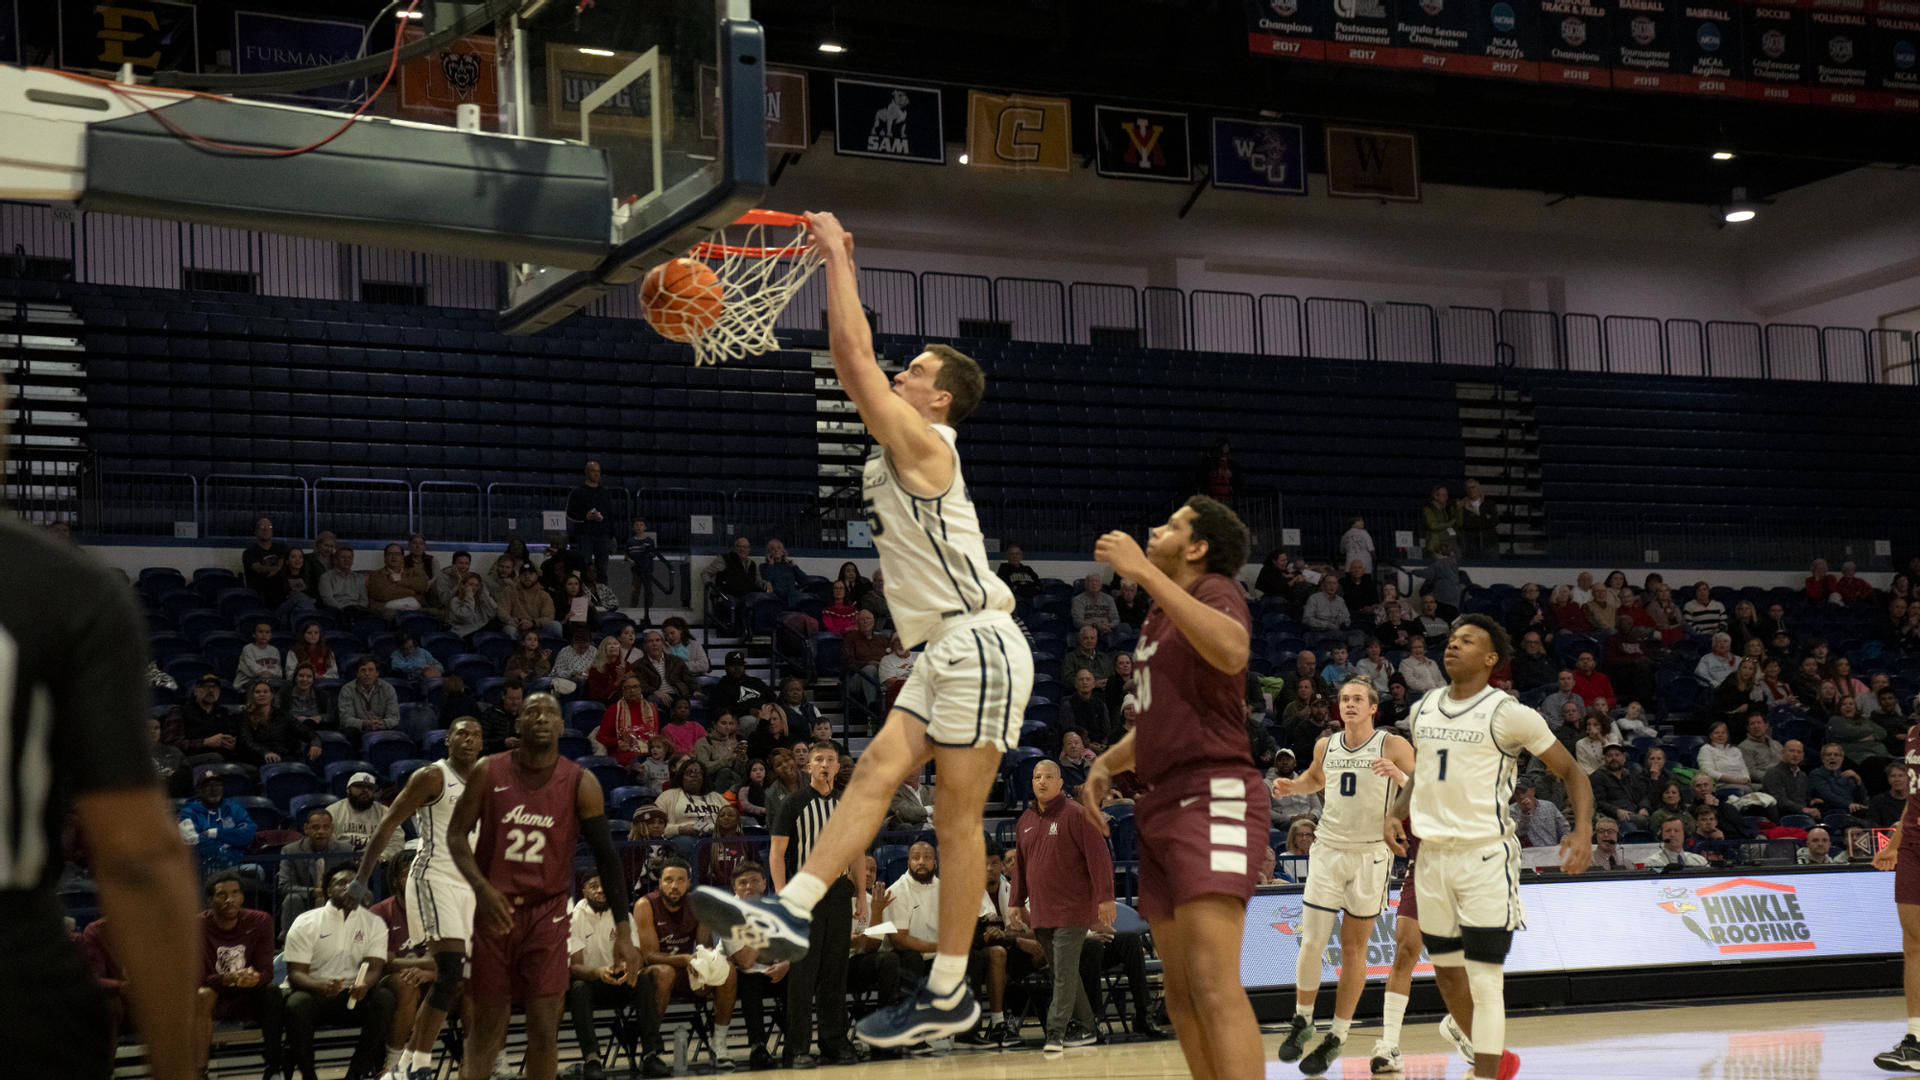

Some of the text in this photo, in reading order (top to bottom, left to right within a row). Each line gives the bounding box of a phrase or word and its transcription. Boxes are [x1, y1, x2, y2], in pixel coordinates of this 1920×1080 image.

[1755, 7, 1791, 20] SOCCER
[1258, 18, 1313, 34] Champions
[1335, 22, 1388, 36] Postseason
[1398, 22, 1468, 39] Regular Season
[1334, 32, 1390, 45] Tournament
[1408, 34, 1459, 48] Champions
[1492, 37, 1518, 48] NCAA
[1272, 40, 1301, 53] 2017
[1486, 45, 1524, 60] Playoffs
[1620, 46, 1670, 59] Tournament
[246, 46, 335, 67] FURMAN
[1349, 48, 1377, 60] 2017
[1422, 54, 1446, 67] 2017
[1551, 48, 1600, 62] Champions
[1492, 62, 1518, 73] 2017
[1622, 55, 1670, 69] Champions
[1698, 57, 1724, 68] NCAA
[1563, 69, 1590, 81] 2018
[1634, 76, 1660, 87] 2018
[996, 106, 1045, 162] C
[867, 135, 909, 154] SAM
[1416, 727, 1485, 744] SAMFORD
[1326, 758, 1374, 769] SAMFOR
[1436, 749, 1448, 782] 1
[1339, 772, 1357, 797] 0
[684, 804, 720, 814] AAMU
[501, 804, 555, 829] Aamu
[504, 828, 547, 864] 22
[1701, 893, 1806, 924] HINKLE
[1709, 922, 1811, 945] ROOFING
